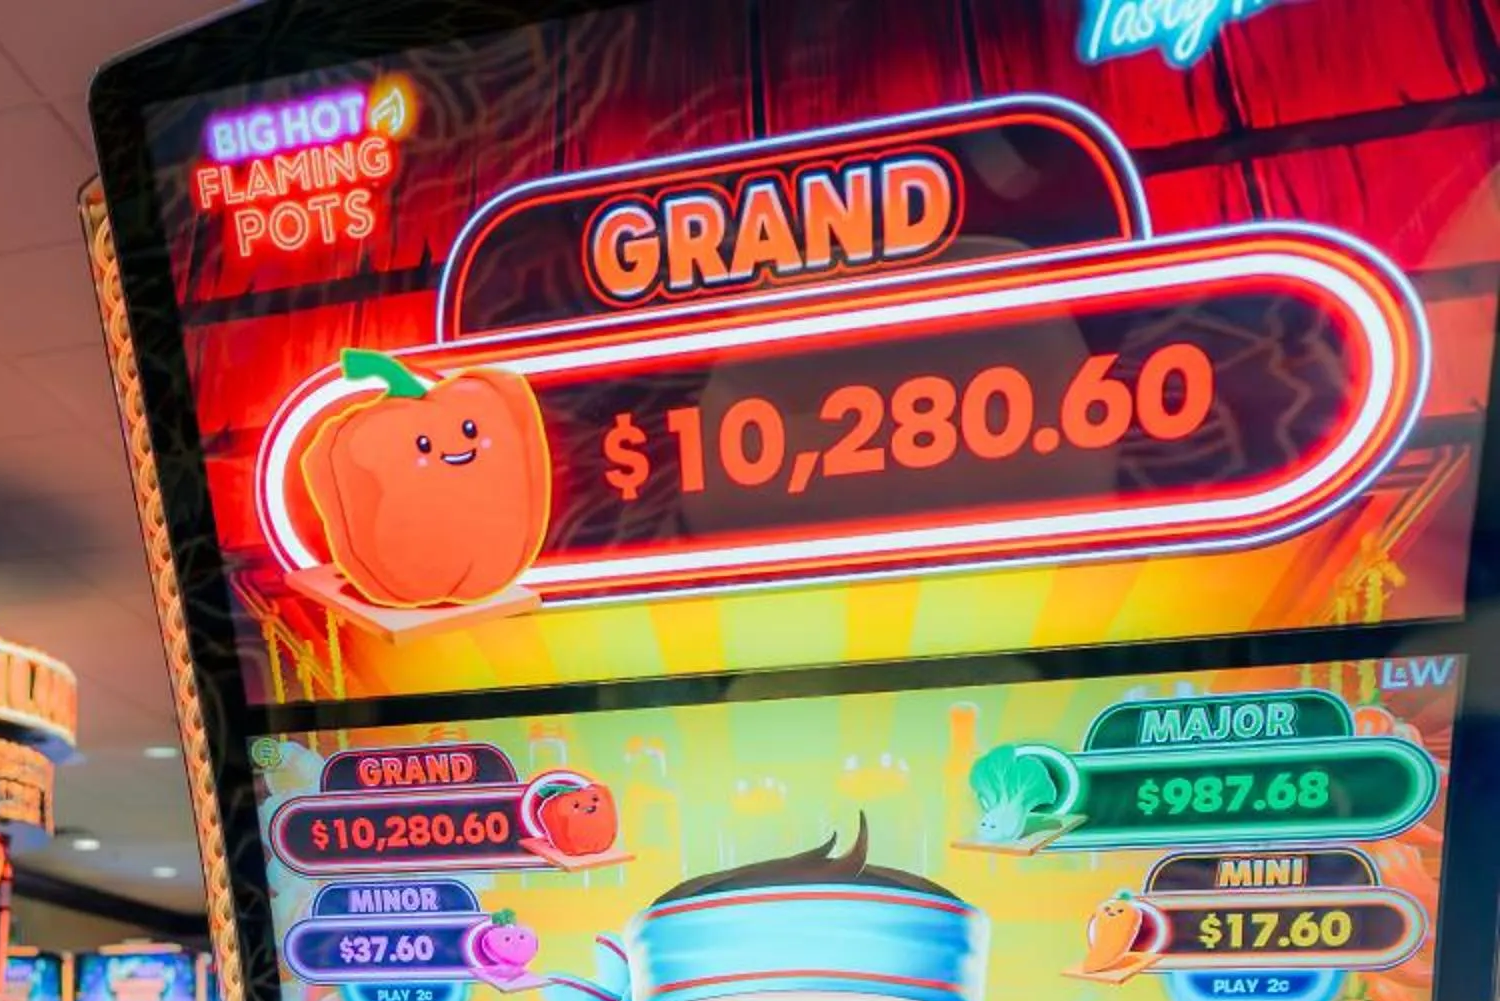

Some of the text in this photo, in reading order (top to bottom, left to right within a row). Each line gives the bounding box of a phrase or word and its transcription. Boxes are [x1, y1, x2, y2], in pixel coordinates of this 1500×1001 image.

[213, 93, 366, 160] BIG HOT
[196, 137, 390, 209] FLAMING
[235, 190, 374, 257] POTS
[592, 157, 954, 300] GRAND
[1139, 702, 1299, 744] MAJOR
[357, 753, 477, 786] GRAND
[1137, 771, 1329, 816] $987.68
[312, 812, 509, 851] $10,280.60
[1217, 855, 1307, 889] MINI
[349, 886, 440, 914] MINOR
[339, 936, 434, 964] $37.60
[1199, 910, 1353, 950] $17.60
[1213, 977, 1260, 993] PLAY
